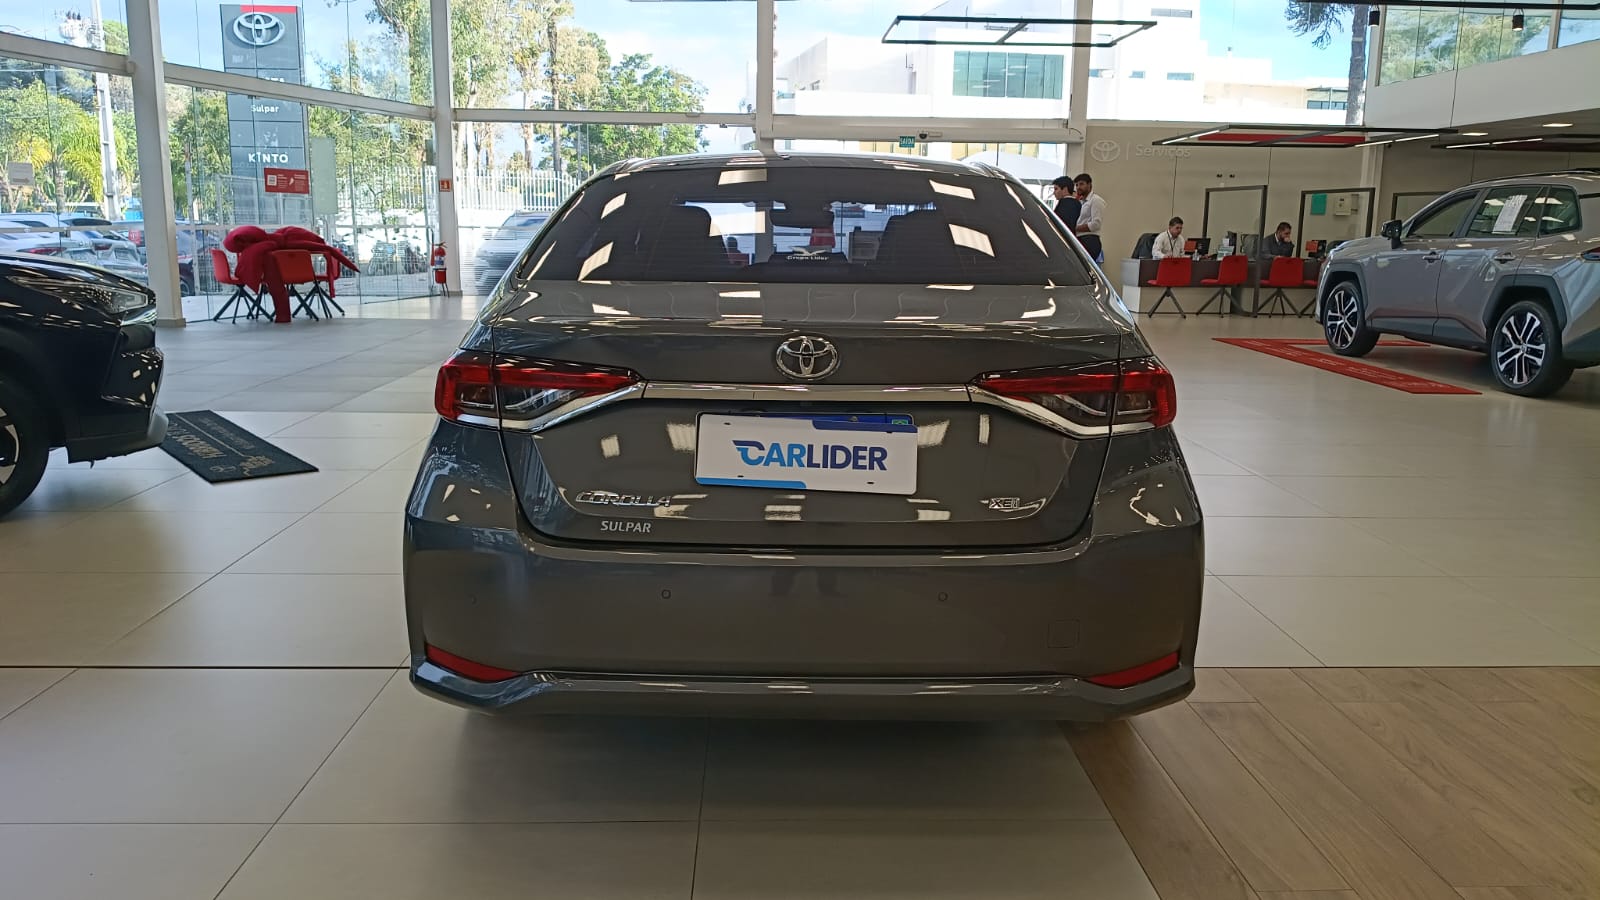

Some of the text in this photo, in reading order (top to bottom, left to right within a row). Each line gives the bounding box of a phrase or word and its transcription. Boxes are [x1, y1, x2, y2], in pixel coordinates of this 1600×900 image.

[251, 104, 279, 113] Sulpar
[1135, 143, 1192, 158] Serviços
[732, 439, 888, 471] CARLIDER
[575, 490, 671, 507] COROLLA
[600, 520, 652, 533] SULPAR
